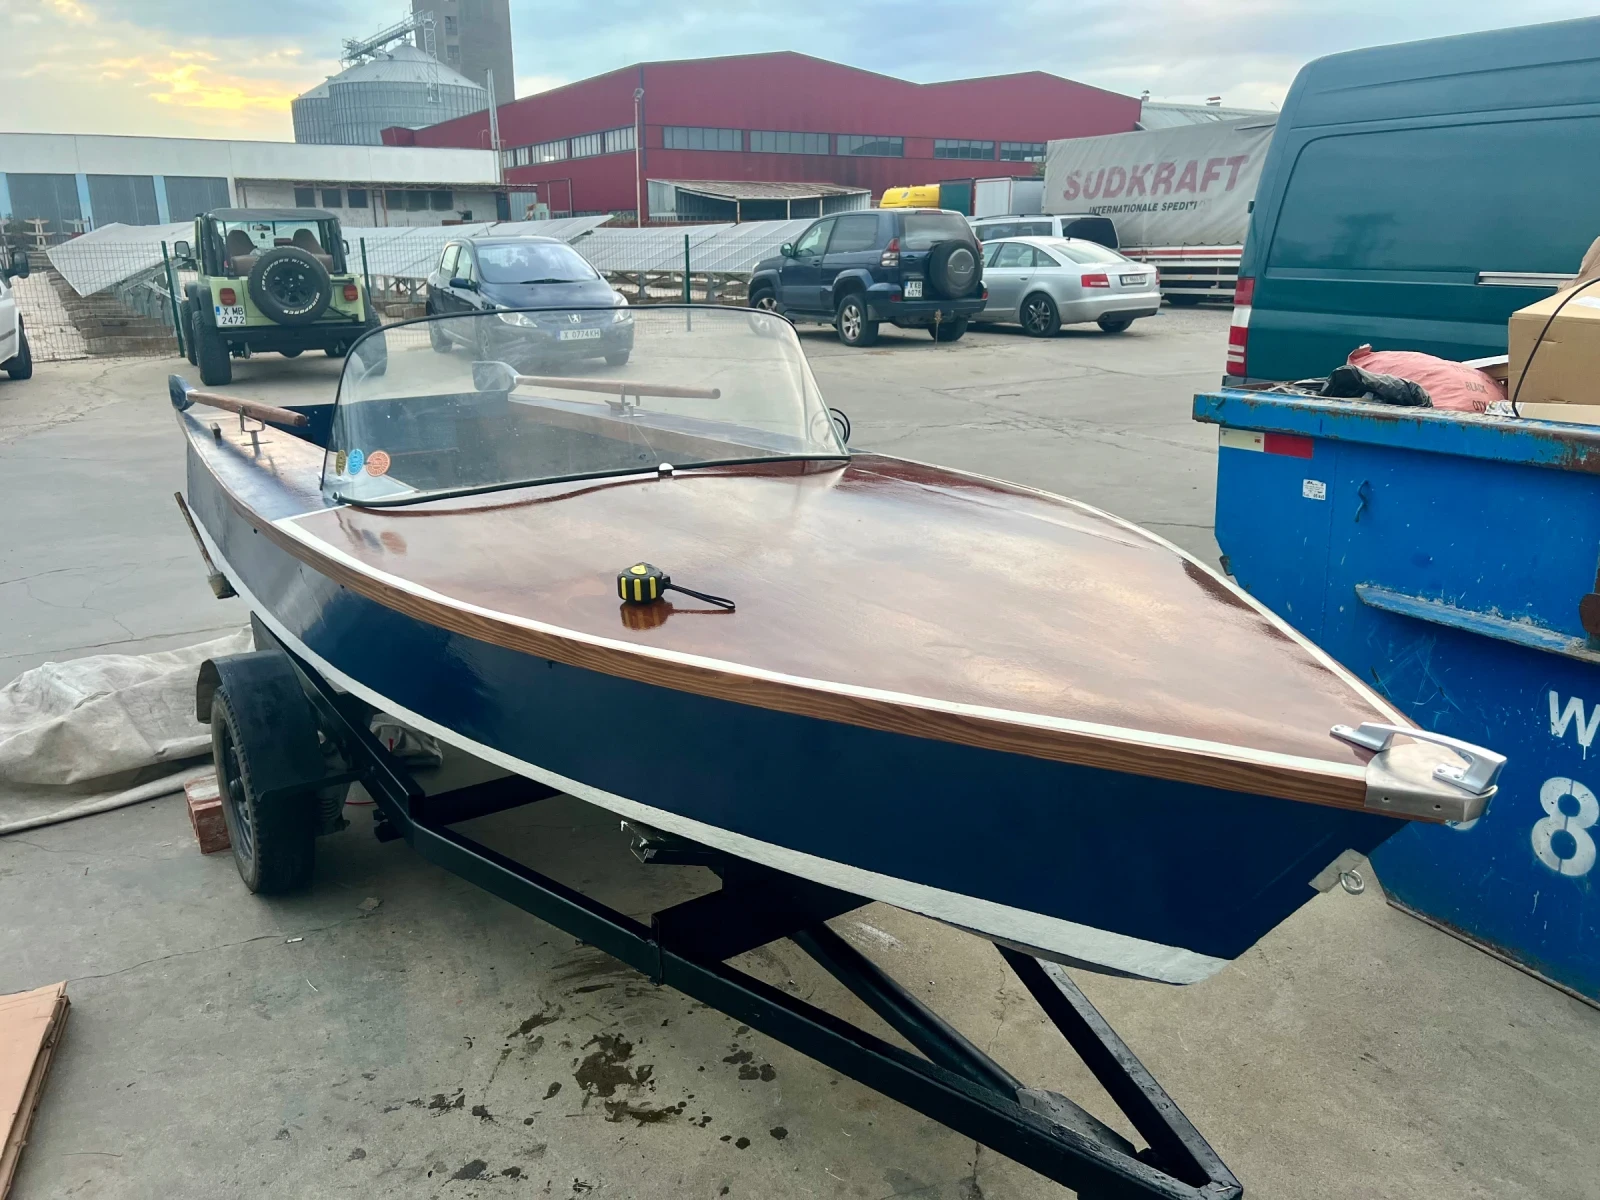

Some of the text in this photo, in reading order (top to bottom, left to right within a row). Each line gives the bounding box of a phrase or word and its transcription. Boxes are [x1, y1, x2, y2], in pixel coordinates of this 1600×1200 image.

[1063, 155, 1249, 201] SUDKRAFT
[1089, 201, 1158, 215] INTERNATIONALE
[223, 307, 244, 315] X MB
[221, 316, 245, 325] 2472
[1465, 381, 1489, 395] BLACK
[1531, 777, 1600, 876] 8
